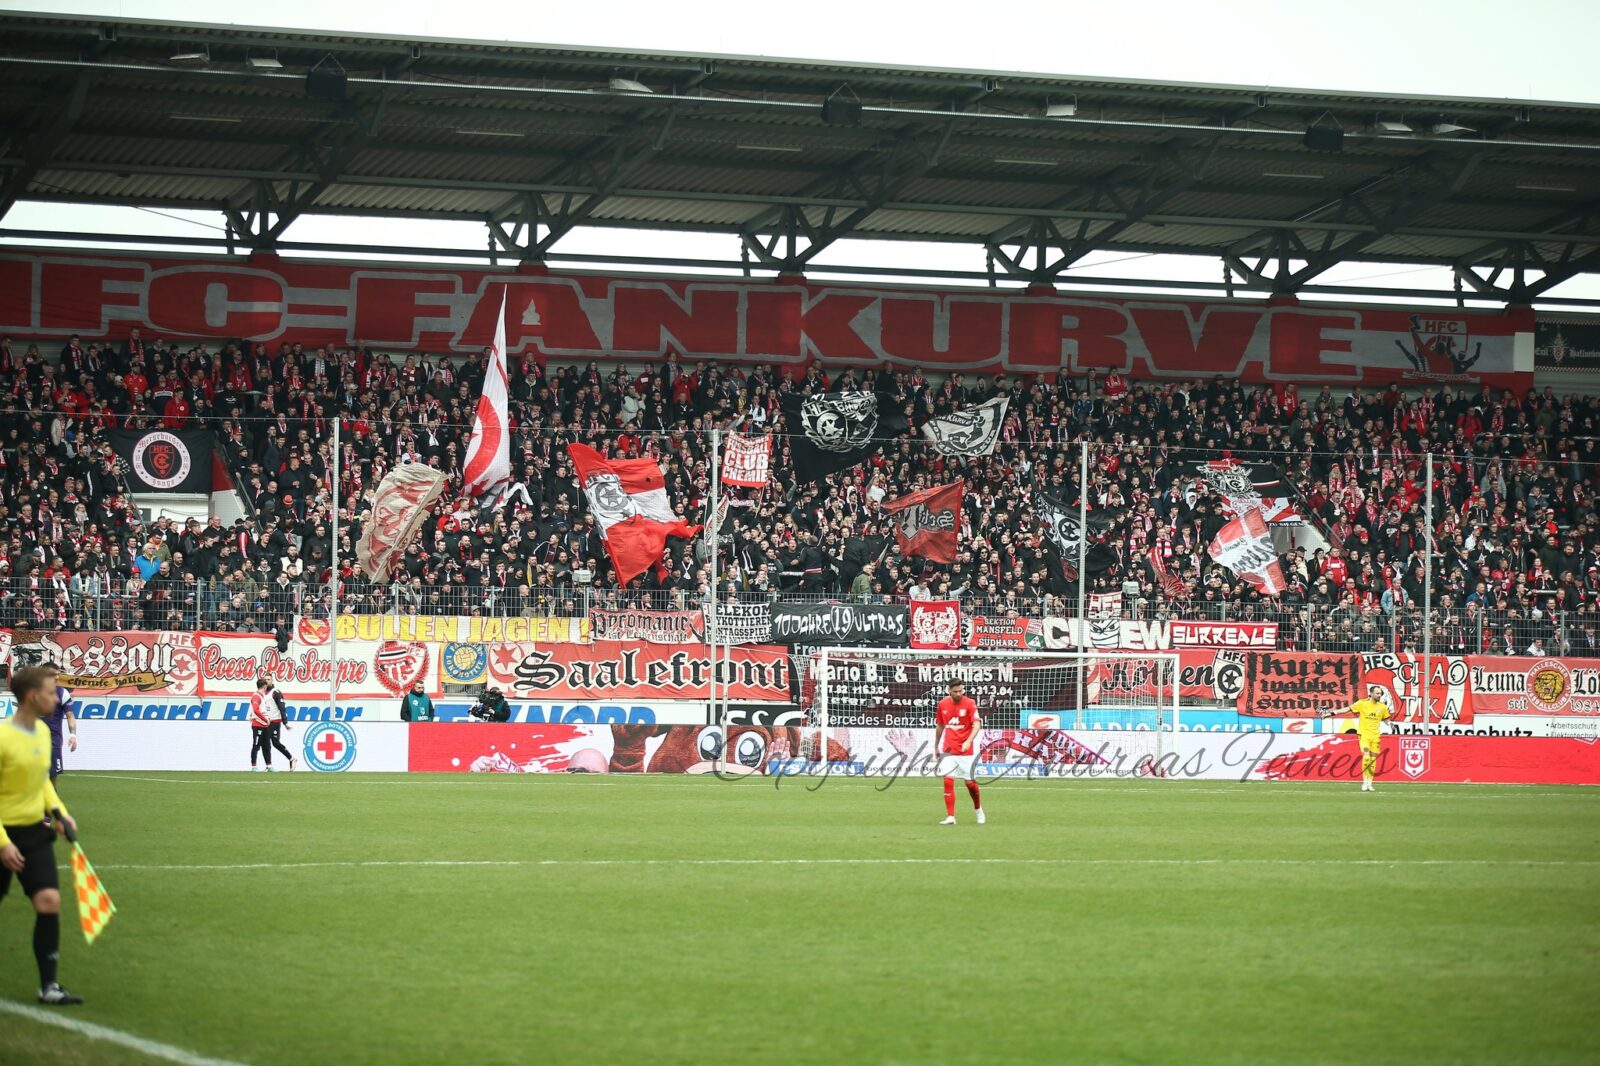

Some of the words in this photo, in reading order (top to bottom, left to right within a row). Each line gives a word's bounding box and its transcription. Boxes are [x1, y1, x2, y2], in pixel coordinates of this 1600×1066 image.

[1425, 320, 1458, 333] HFC
[724, 450, 768, 470] CLUB
[723, 466, 768, 482] CHEMIE
[336, 615, 458, 641] BULLEN
[466, 617, 571, 642] JAGEN
[591, 612, 689, 638] Pyromanie
[791, 613, 831, 636] JAHRE
[854, 612, 903, 636] ULTRAS
[976, 626, 1023, 635] MANSFELD
[984, 618, 1016, 626] SEKTION
[978, 637, 1019, 647] SÜDHARZ
[1173, 626, 1276, 646] SURREALE
[201, 643, 256, 681] Coesa
[258, 647, 294, 683] Per
[296, 648, 367, 692] Sempre
[514, 650, 790, 691] Saalefront
[810, 658, 860, 681] Mario
[894, 663, 908, 682] &
[918, 662, 993, 682] Matthias
[998, 663, 1018, 683] M.
[1530, 660, 1568, 677] HALLESCHER
[1473, 666, 1526, 692] Leuna
[1572, 668, 1600, 696] Lö
[1508, 696, 1528, 711] seit
[818, 713, 915, 726] ercedes-Benz
[1402, 740, 1426, 749] HFC
